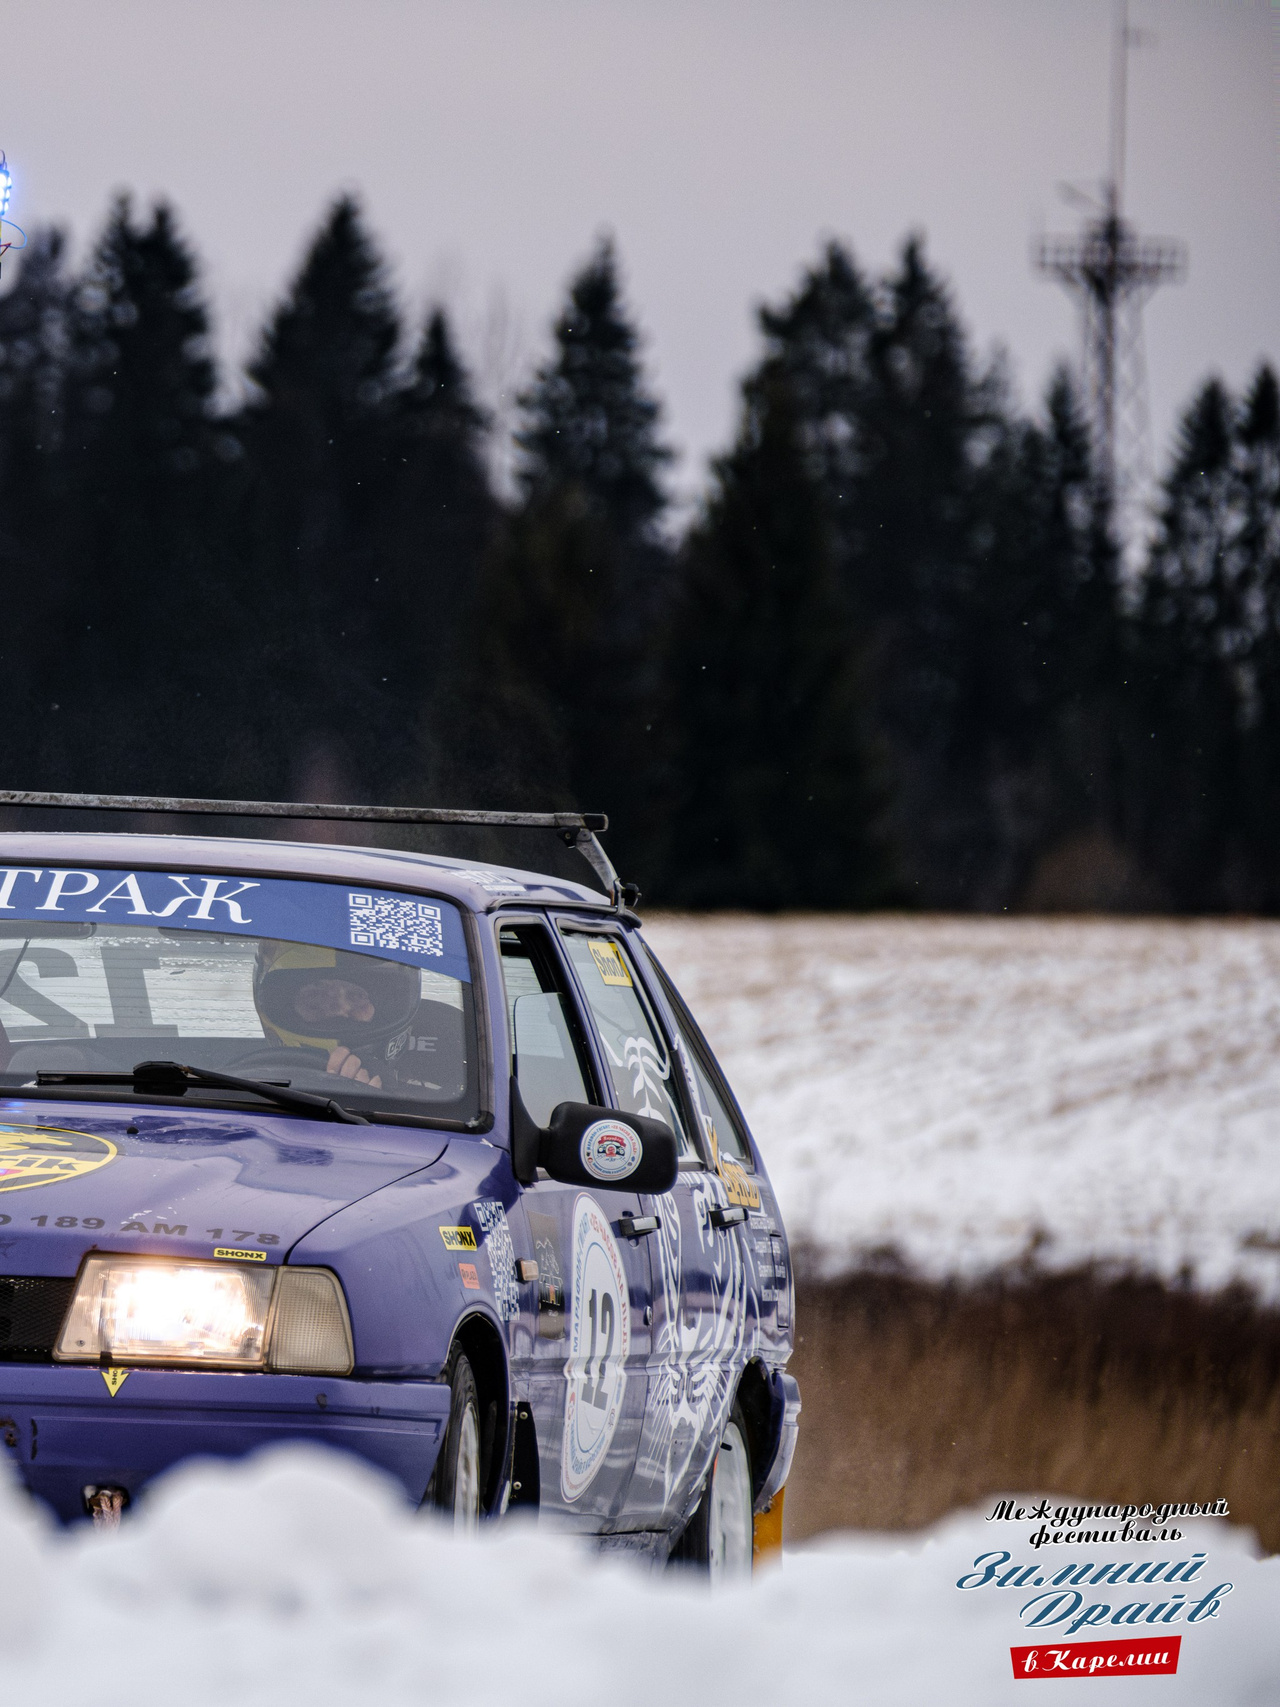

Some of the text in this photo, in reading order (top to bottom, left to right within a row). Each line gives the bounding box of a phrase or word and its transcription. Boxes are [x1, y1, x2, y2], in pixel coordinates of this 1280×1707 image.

[29, 1214, 106, 1231] 189
[119, 1220, 189, 1238] АМ
[205, 1227, 281, 1247] 178
[441, 1230, 476, 1247] SHONX
[217, 1249, 264, 1259] SHONX
[580, 1287, 617, 1412] 12
